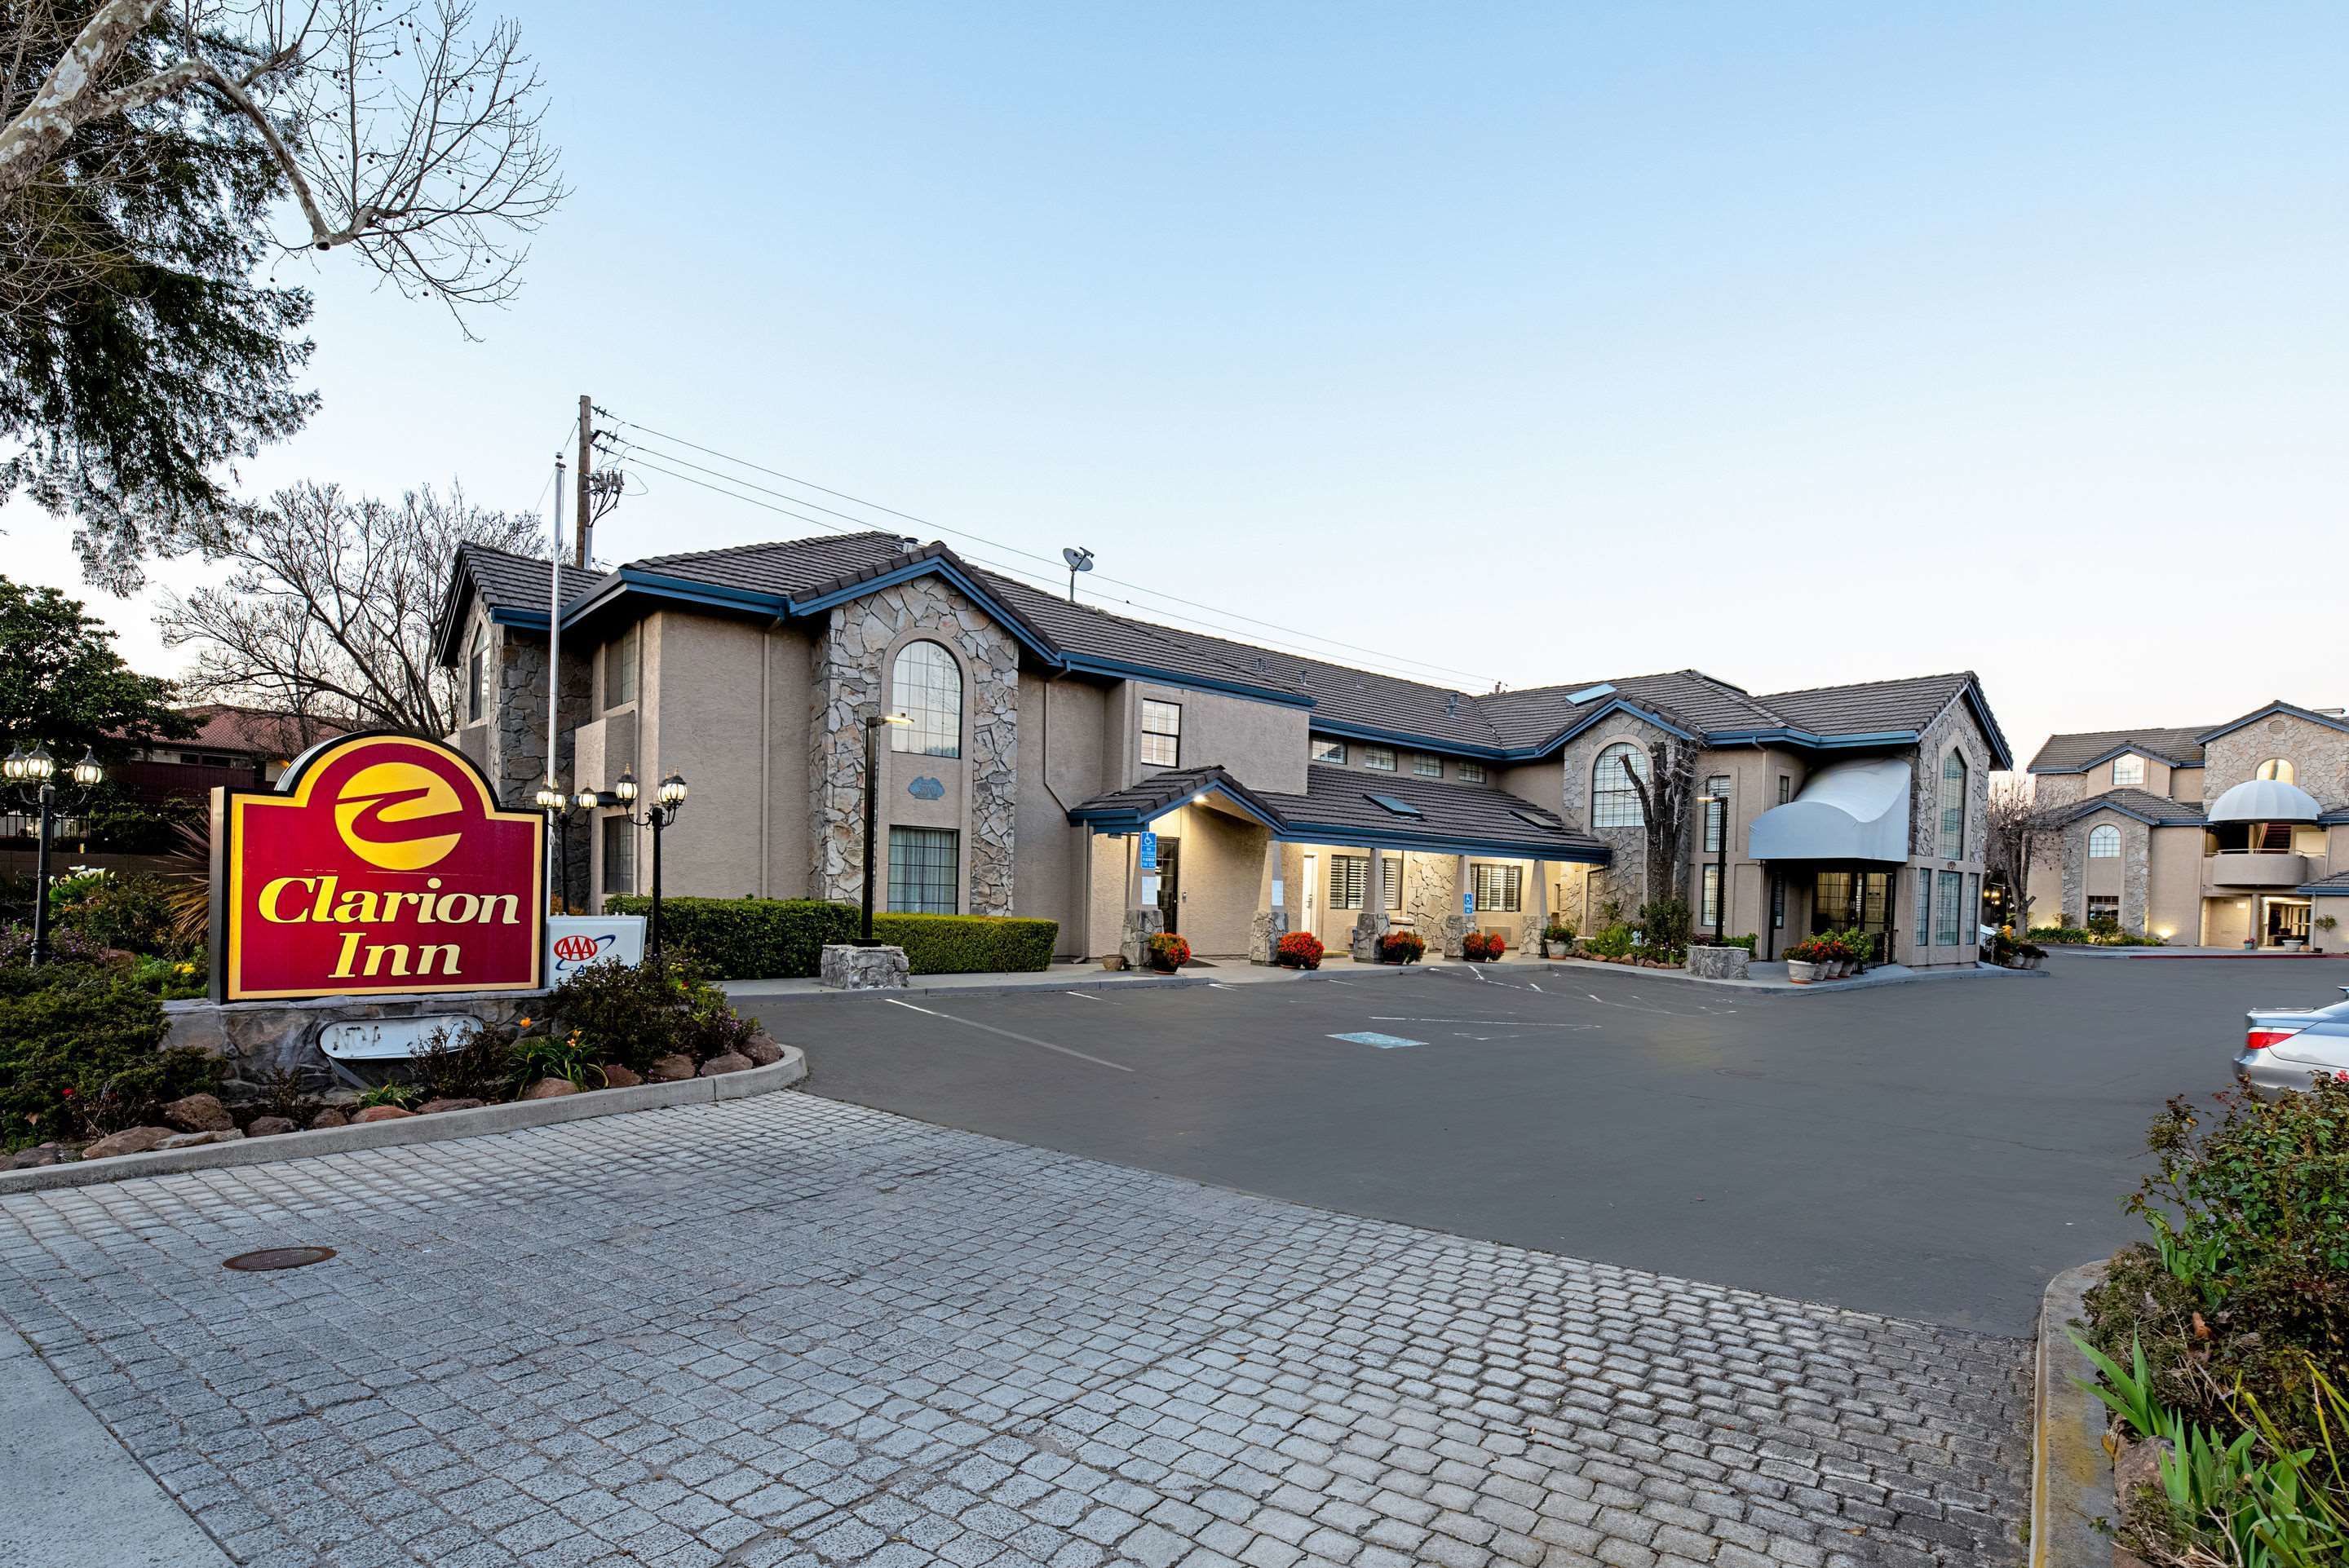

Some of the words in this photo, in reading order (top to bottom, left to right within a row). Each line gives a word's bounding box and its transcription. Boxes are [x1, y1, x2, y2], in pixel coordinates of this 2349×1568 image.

[258, 875, 520, 924] Clarion
[327, 932, 462, 978] Inn
[557, 936, 595, 961] AAA
